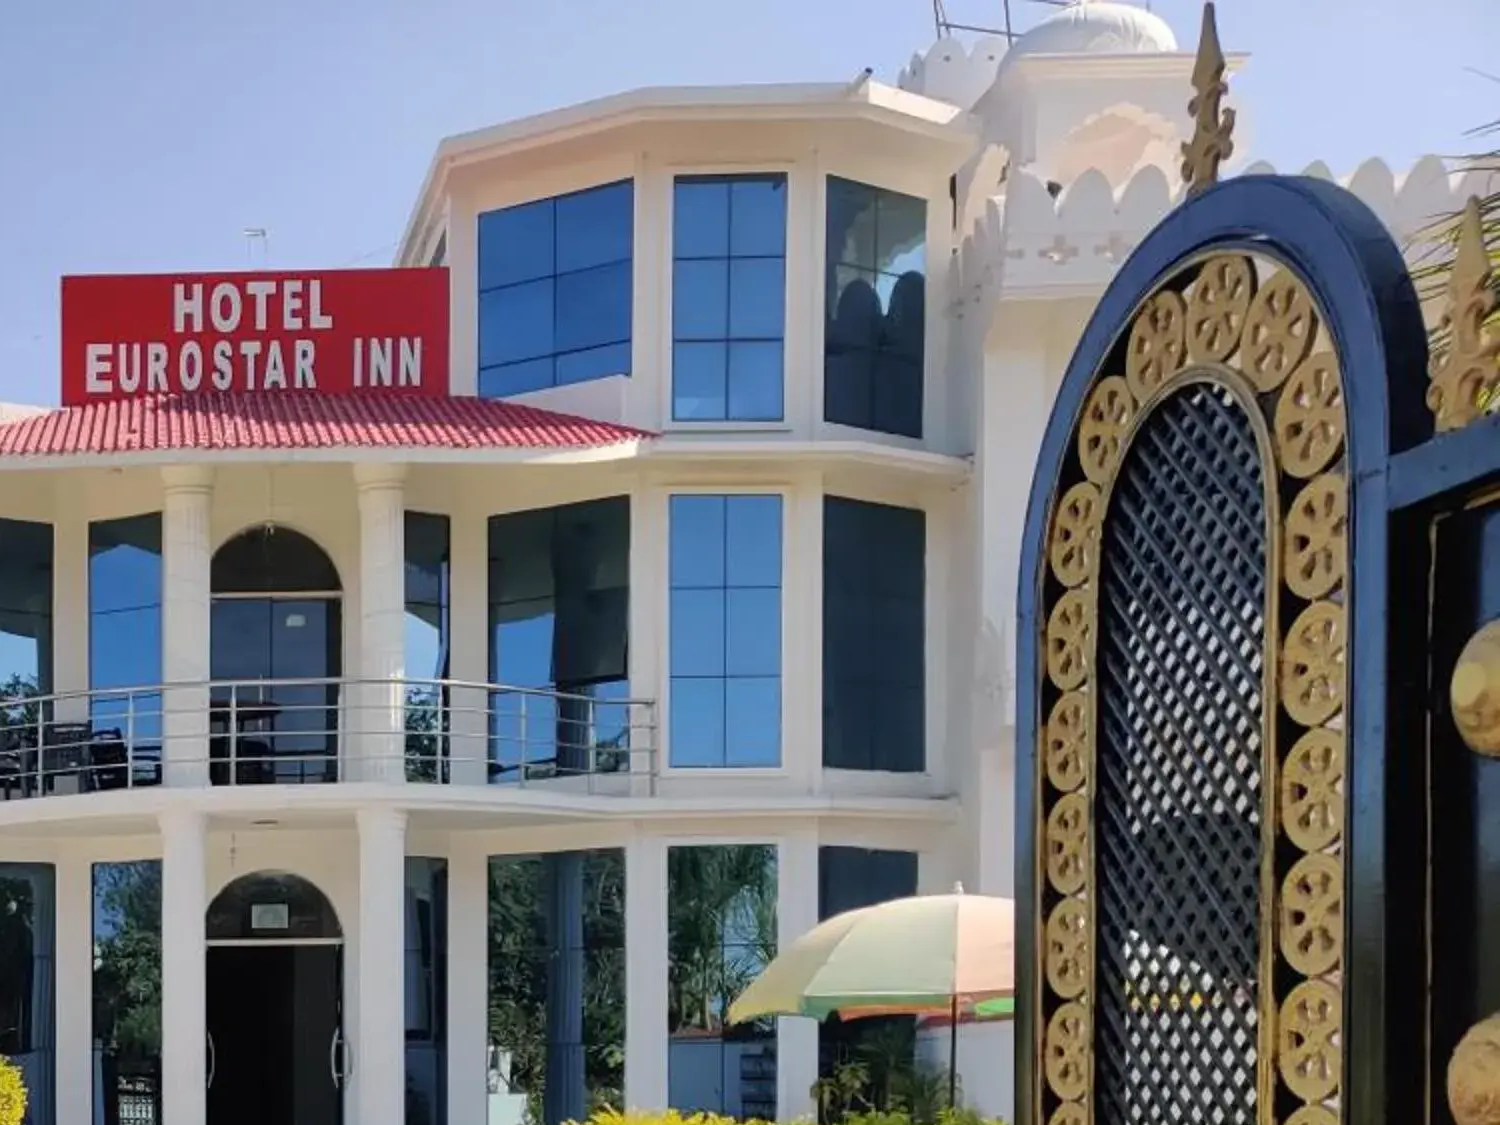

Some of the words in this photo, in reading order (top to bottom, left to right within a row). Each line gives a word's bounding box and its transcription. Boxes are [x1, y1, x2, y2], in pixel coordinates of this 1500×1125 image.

[173, 279, 333, 333] HOTEL
[85, 339, 317, 393] EUROSTAR
[353, 337, 423, 388] INN
